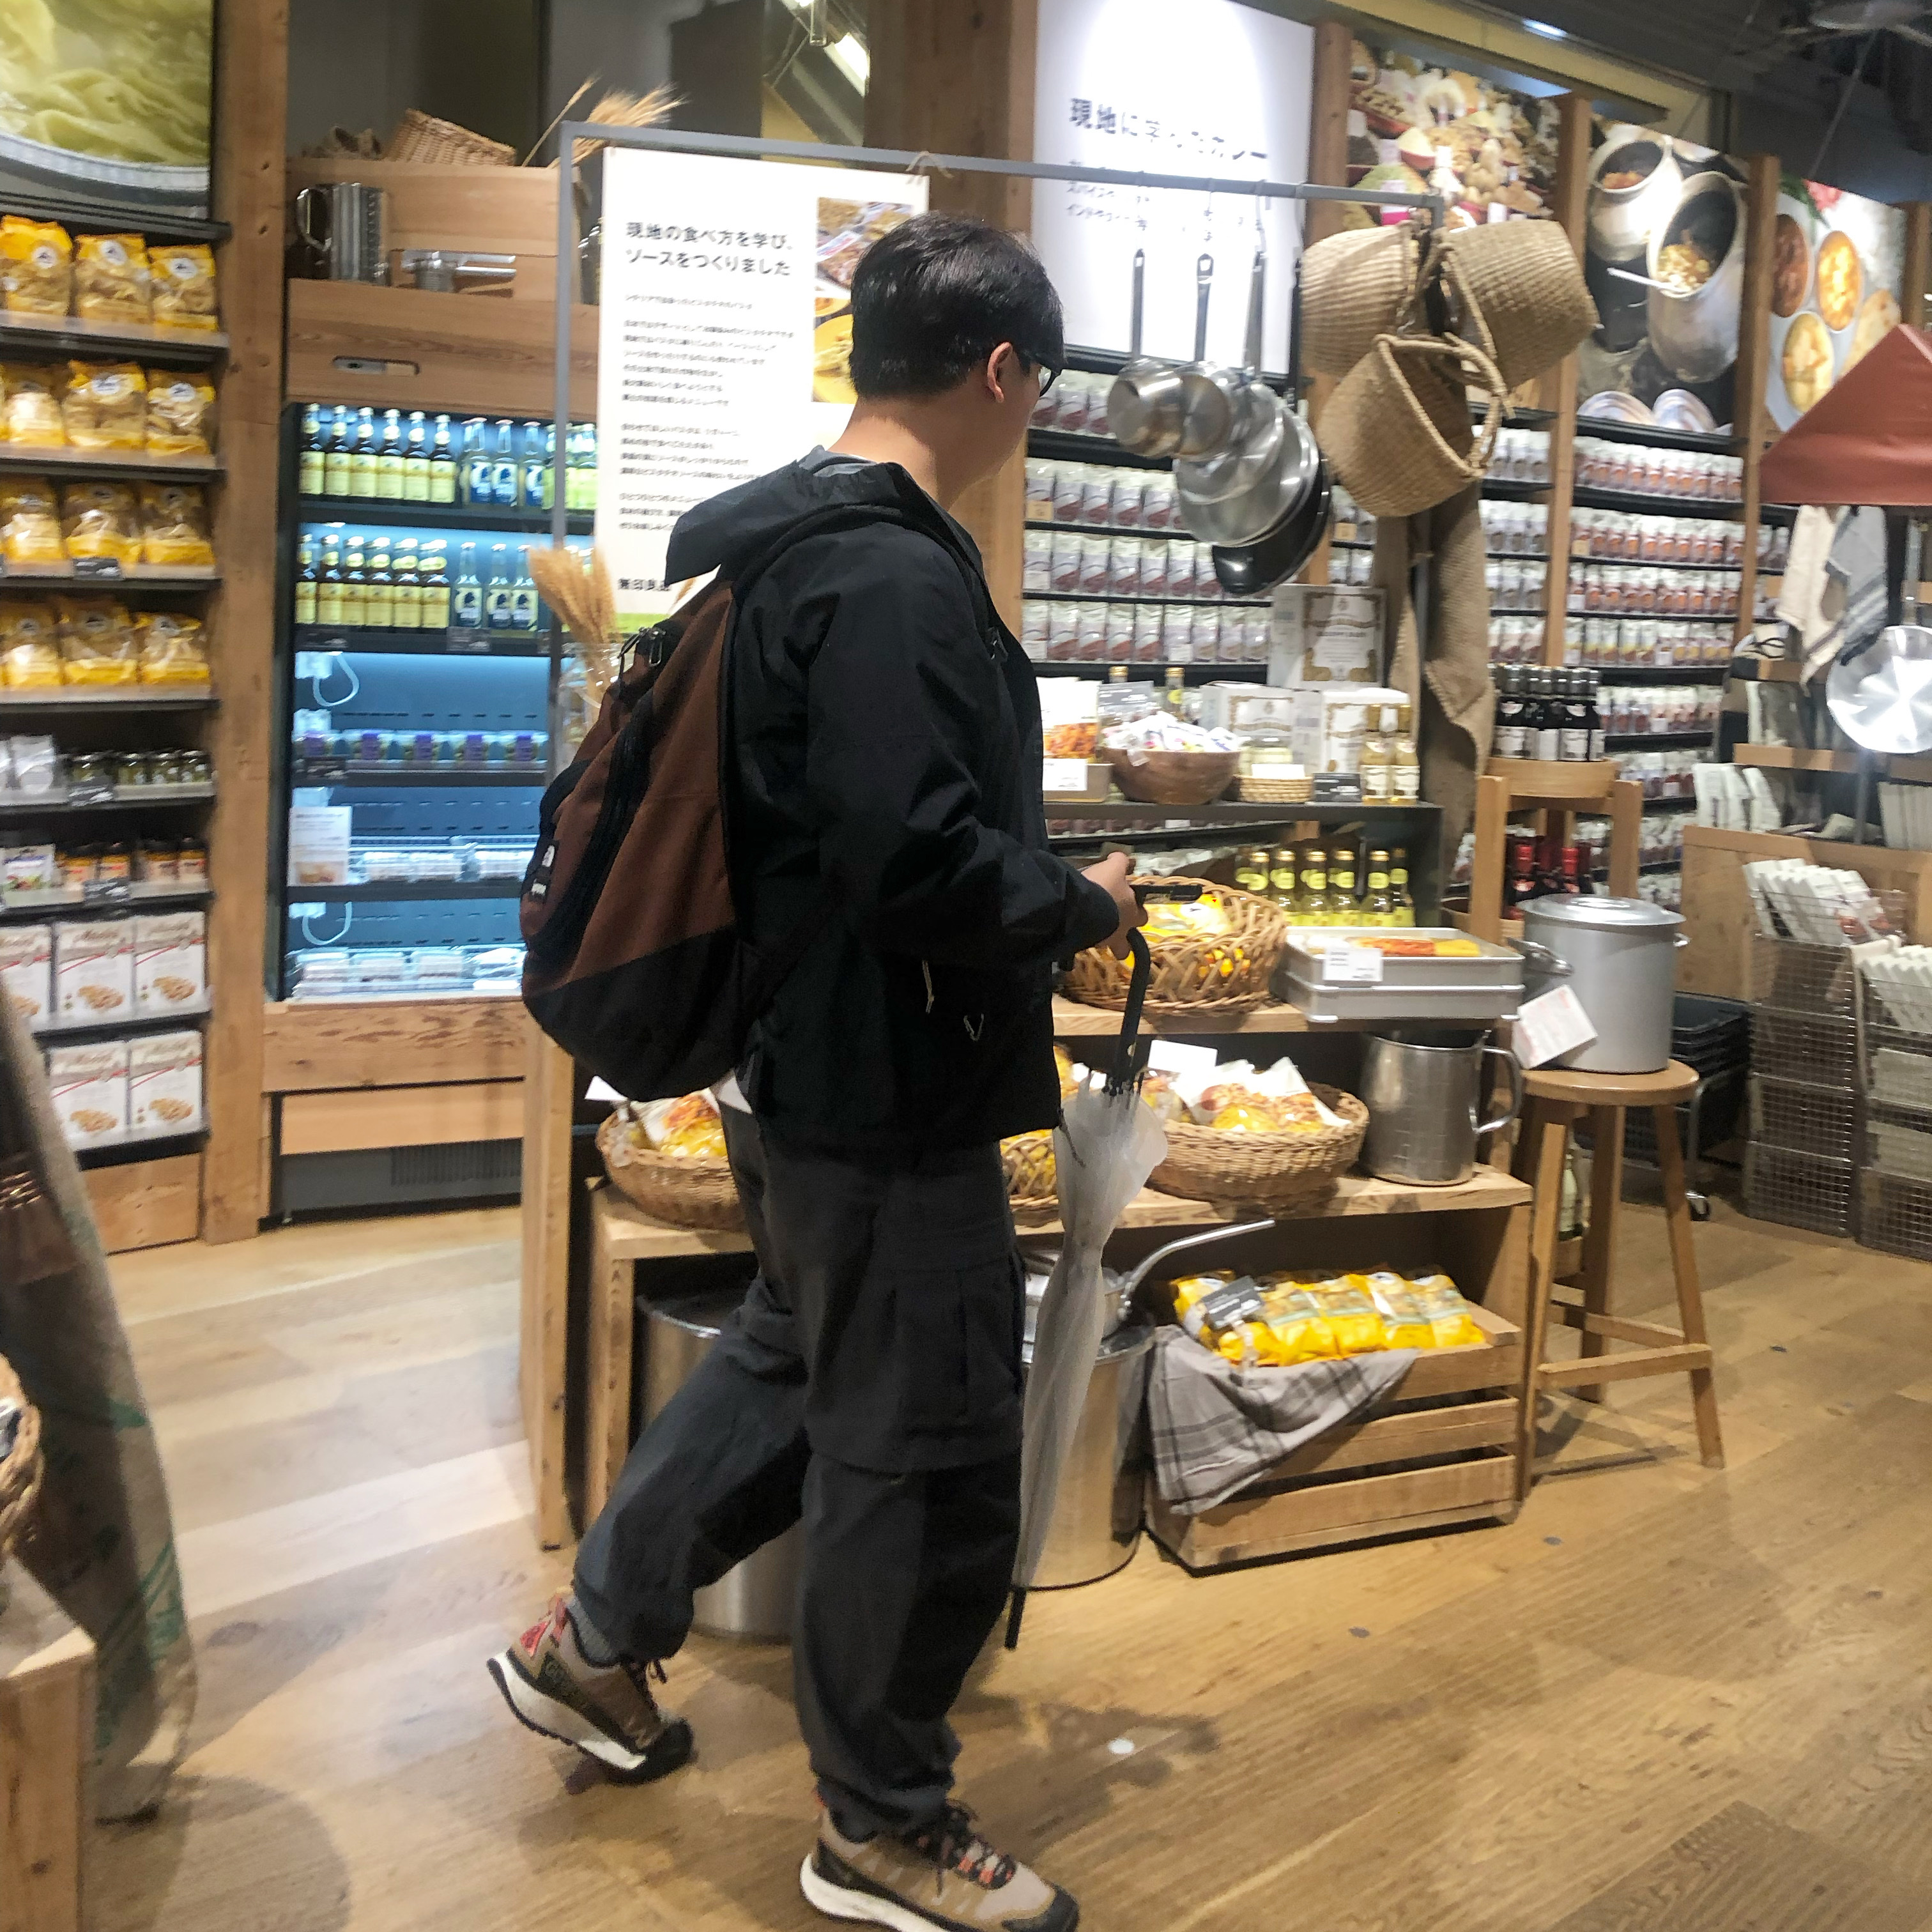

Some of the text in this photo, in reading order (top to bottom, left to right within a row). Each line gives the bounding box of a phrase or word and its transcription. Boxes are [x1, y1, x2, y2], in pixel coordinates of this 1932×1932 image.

[625, 222, 793, 250] 現地の食べ方を学び、
[625, 248, 791, 276] ソースをつくりました
